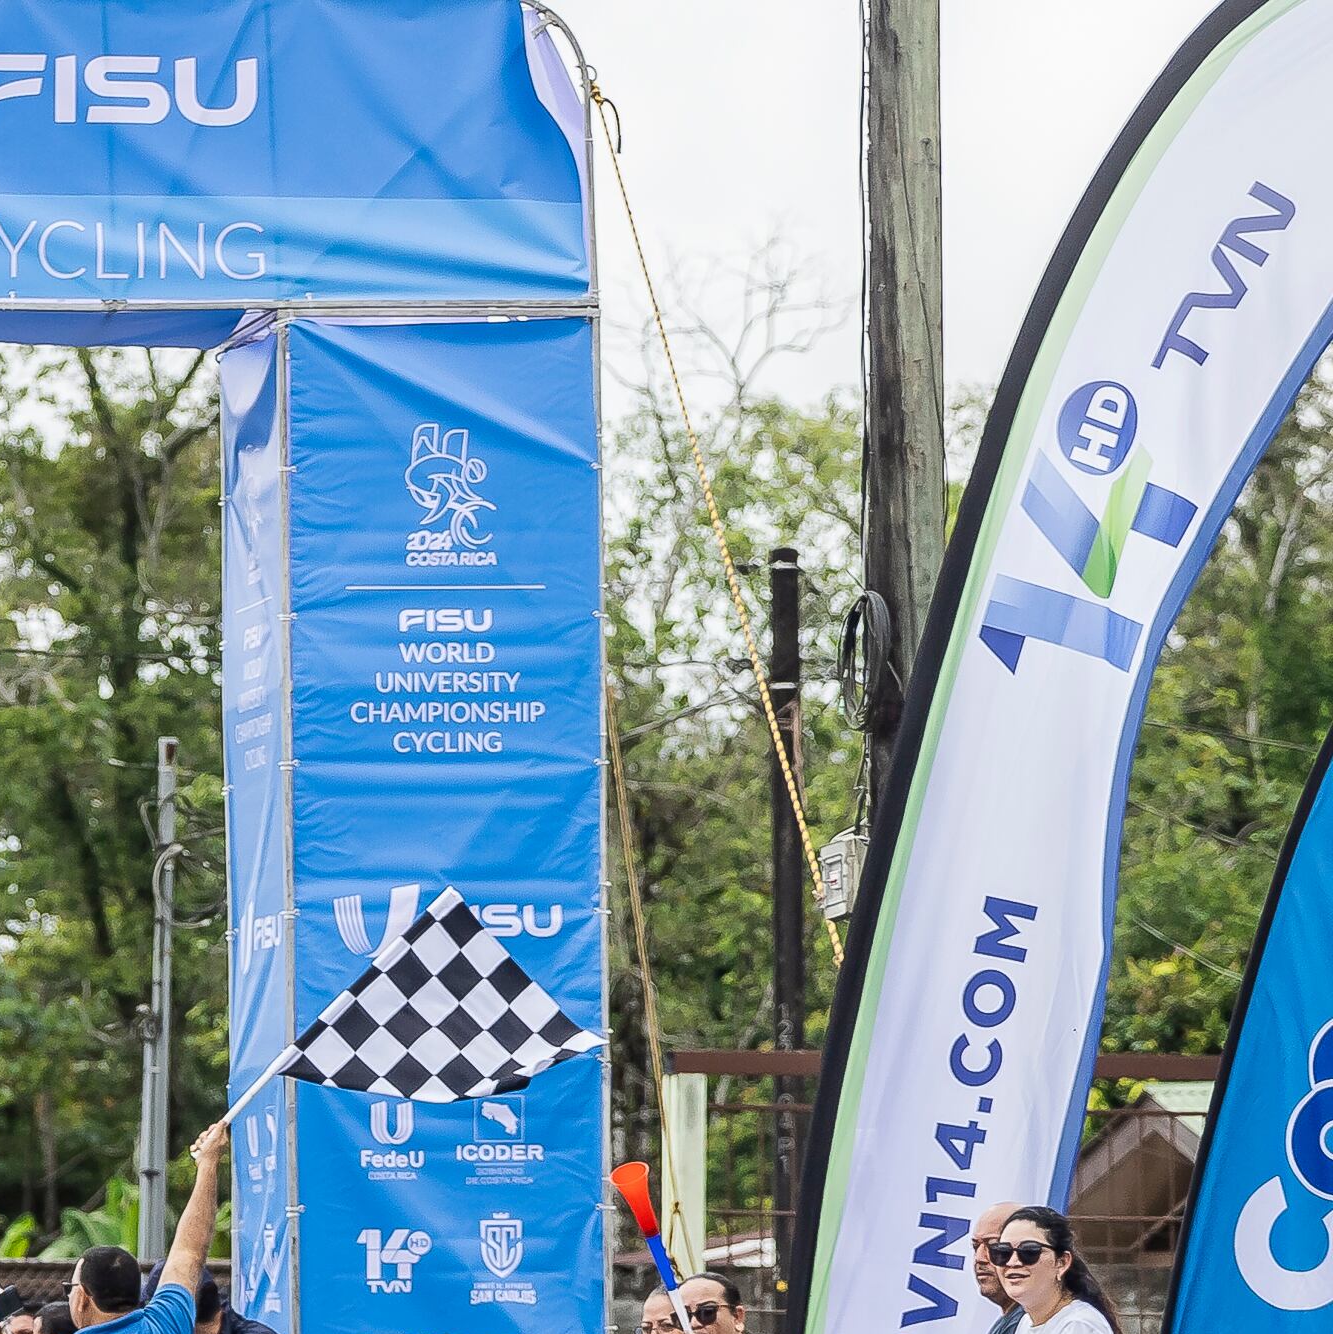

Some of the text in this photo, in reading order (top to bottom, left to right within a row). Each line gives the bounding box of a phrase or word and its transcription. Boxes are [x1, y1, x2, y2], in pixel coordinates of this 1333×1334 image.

[1150, 180, 1296, 369] TVN
[1070, 385, 1131, 472] HD
[406, 552, 497, 567] COSTA RICA
[398, 609, 493, 632] FISU
[399, 642, 495, 663] WORLD
[375, 671, 521, 694] UNIVERSITY
[350, 701, 546, 724] CHAMPIONSHIP
[393, 731, 503, 754] CYCLING
[360, 1150, 425, 1168] FedeU
[456, 1145, 545, 1161] ICODER
[366, 1280, 412, 1293] TVN
